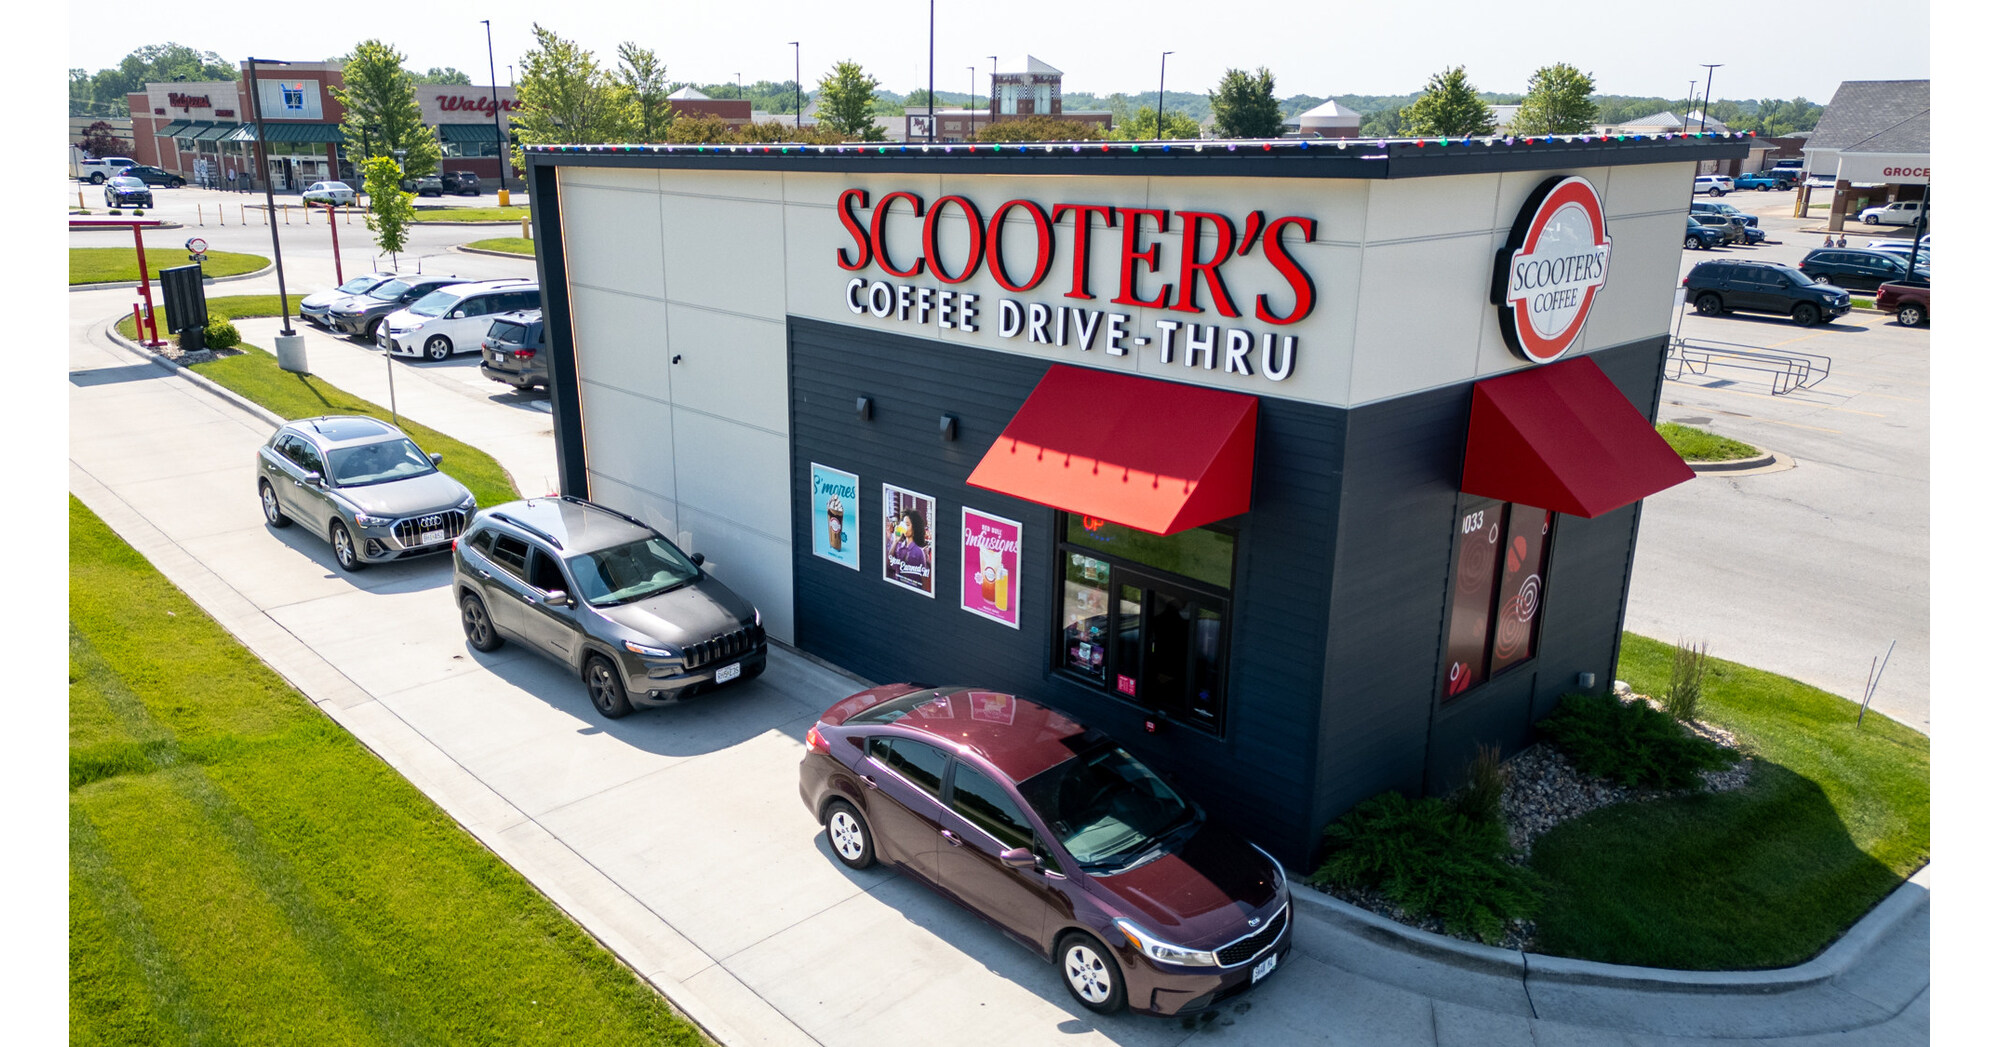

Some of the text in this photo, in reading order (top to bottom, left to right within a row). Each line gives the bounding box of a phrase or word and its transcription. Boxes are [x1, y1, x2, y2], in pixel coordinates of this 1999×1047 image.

[836, 188, 1317, 326] SCOOTER'S
[1513, 251, 1604, 291] SCOOTER'S
[1534, 288, 1578, 313] COFFEE
[846, 277, 1298, 381] COFFEE DRIVE-THRU
[1462, 510, 1484, 534] 1033
